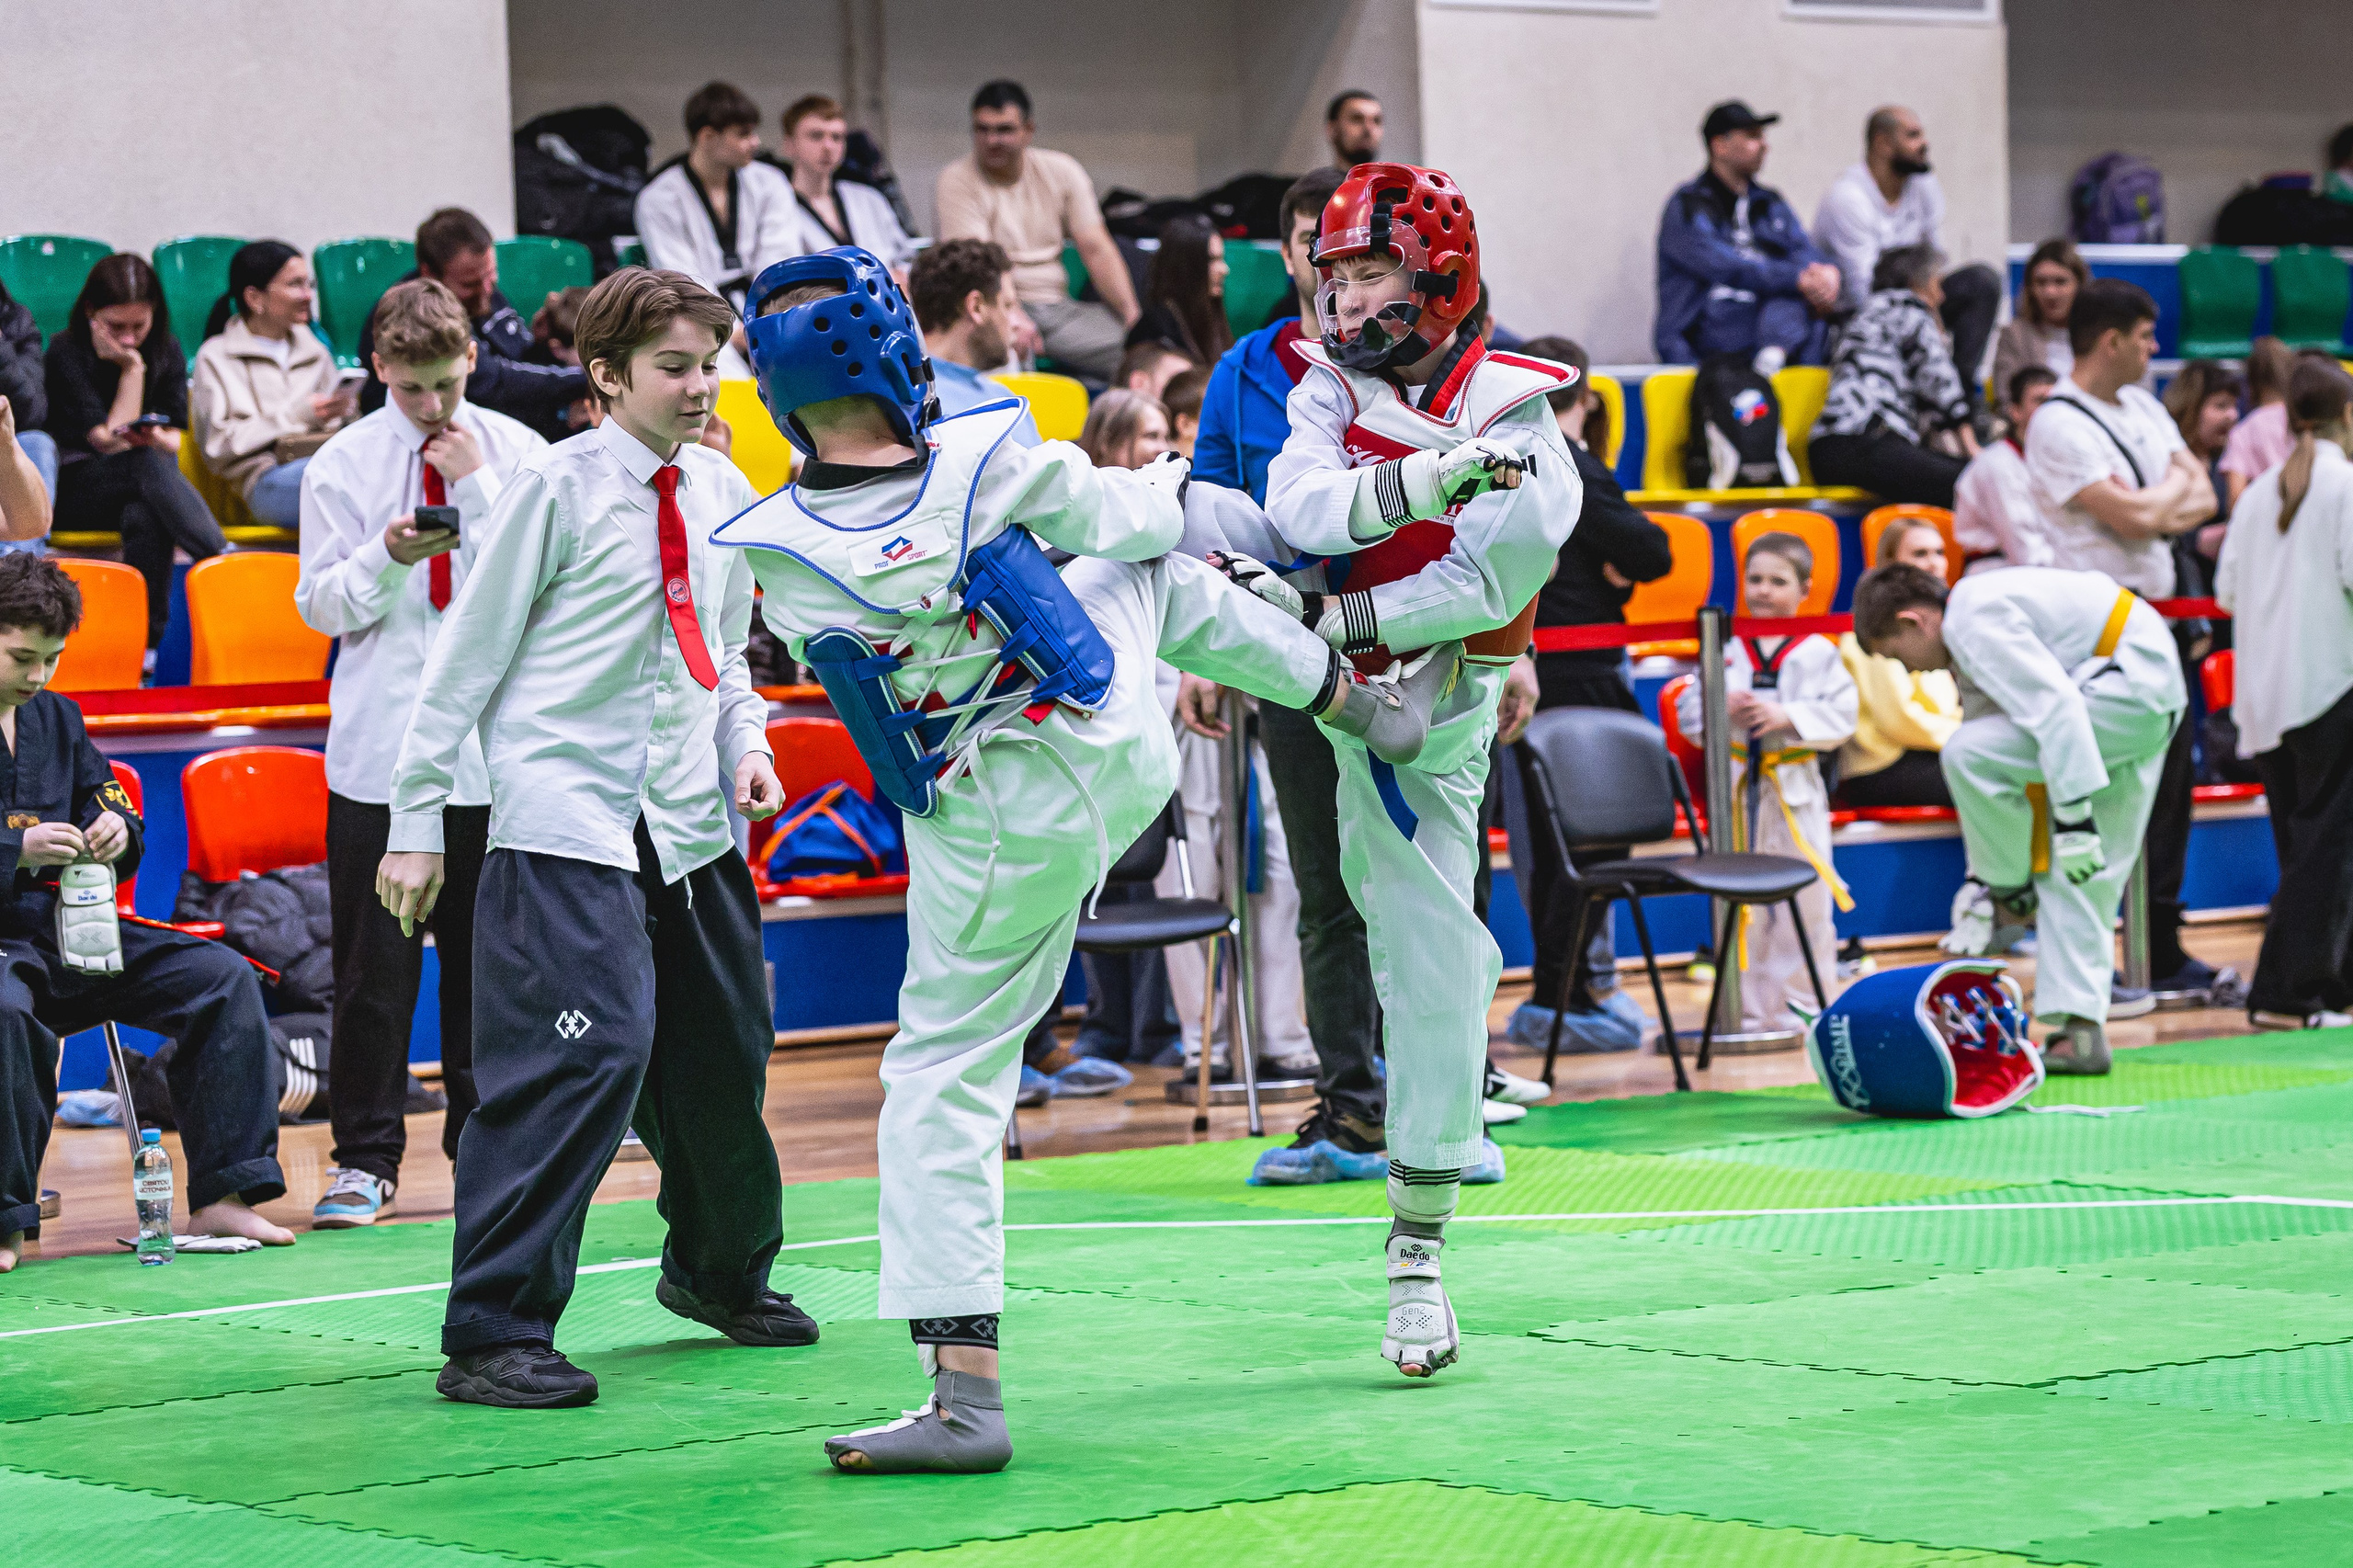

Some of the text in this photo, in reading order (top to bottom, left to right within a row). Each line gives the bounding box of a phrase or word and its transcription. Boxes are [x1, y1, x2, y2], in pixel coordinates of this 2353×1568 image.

[874, 551, 926, 569] PROF SPORT
[1402, 1305, 1426, 1315] Gen2
